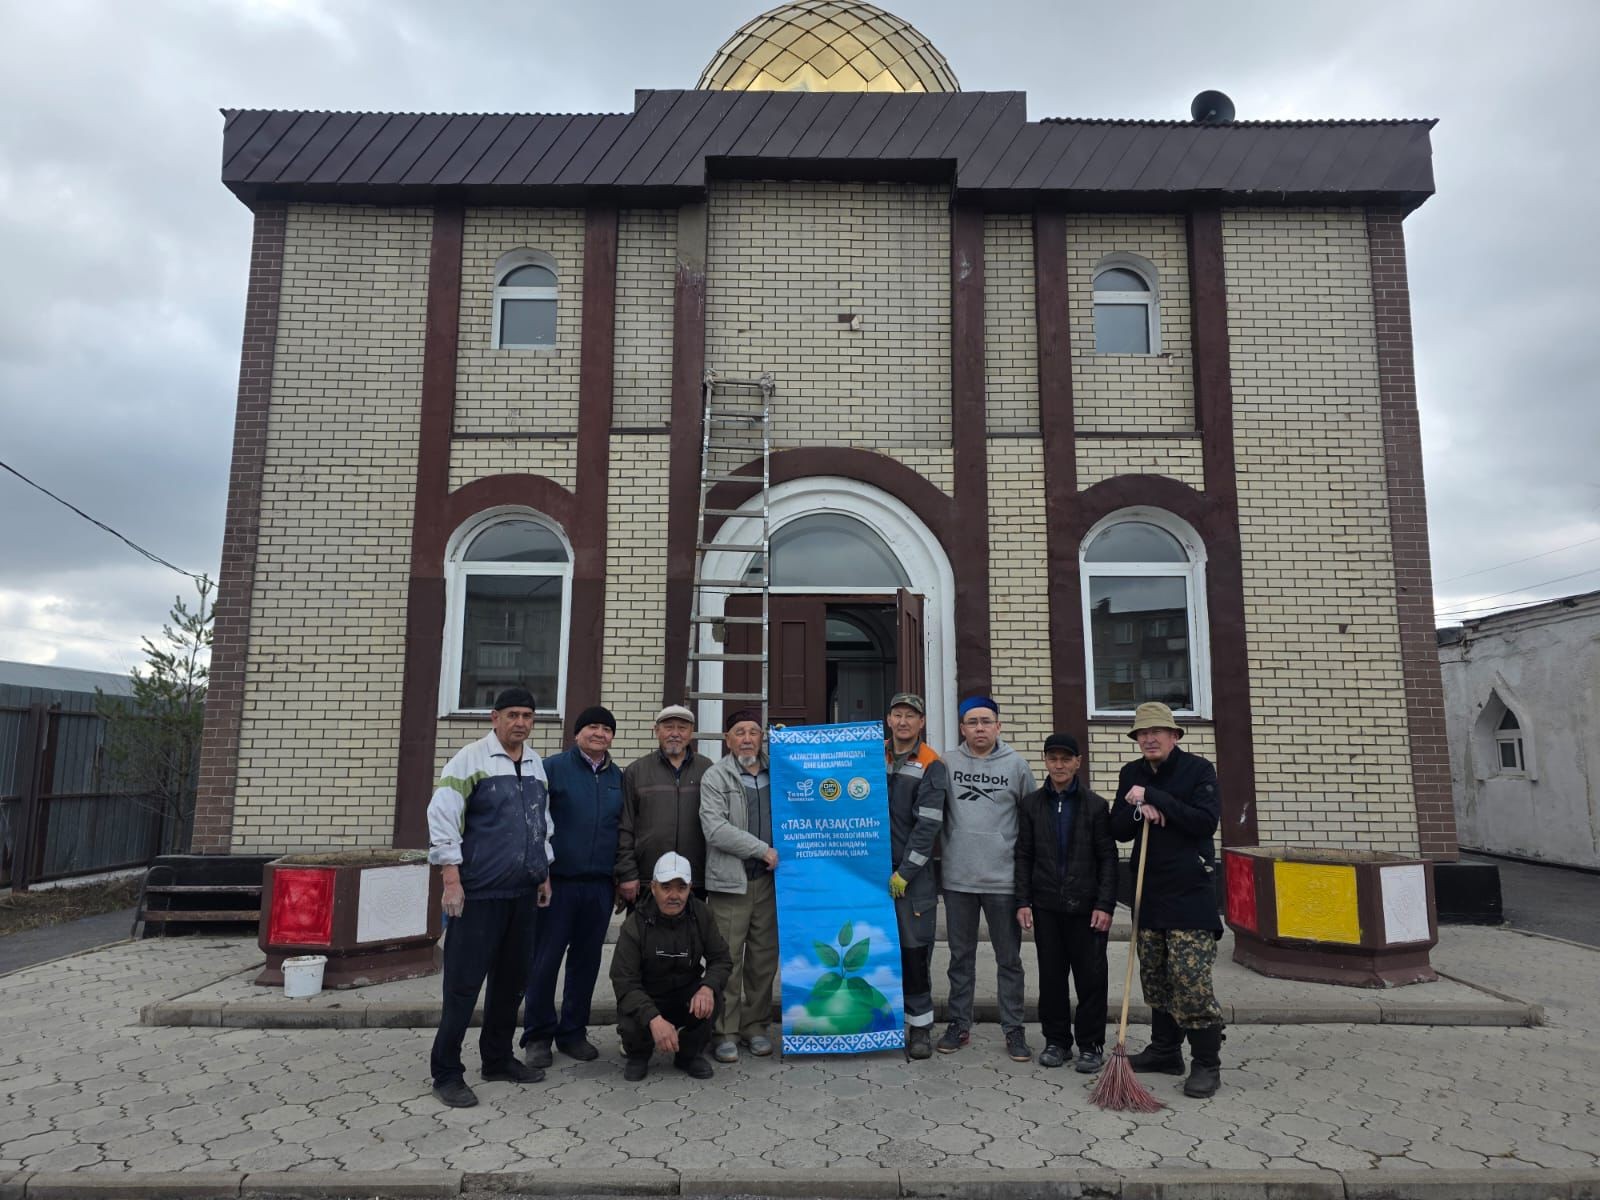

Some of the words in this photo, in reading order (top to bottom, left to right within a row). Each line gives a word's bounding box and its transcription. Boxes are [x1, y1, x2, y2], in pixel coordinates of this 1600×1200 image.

[953, 771, 1009, 786] Reebok
[781, 819, 812, 830] «ТАЗА
[815, 817, 880, 831] ҚАЗАҚСТАН»
